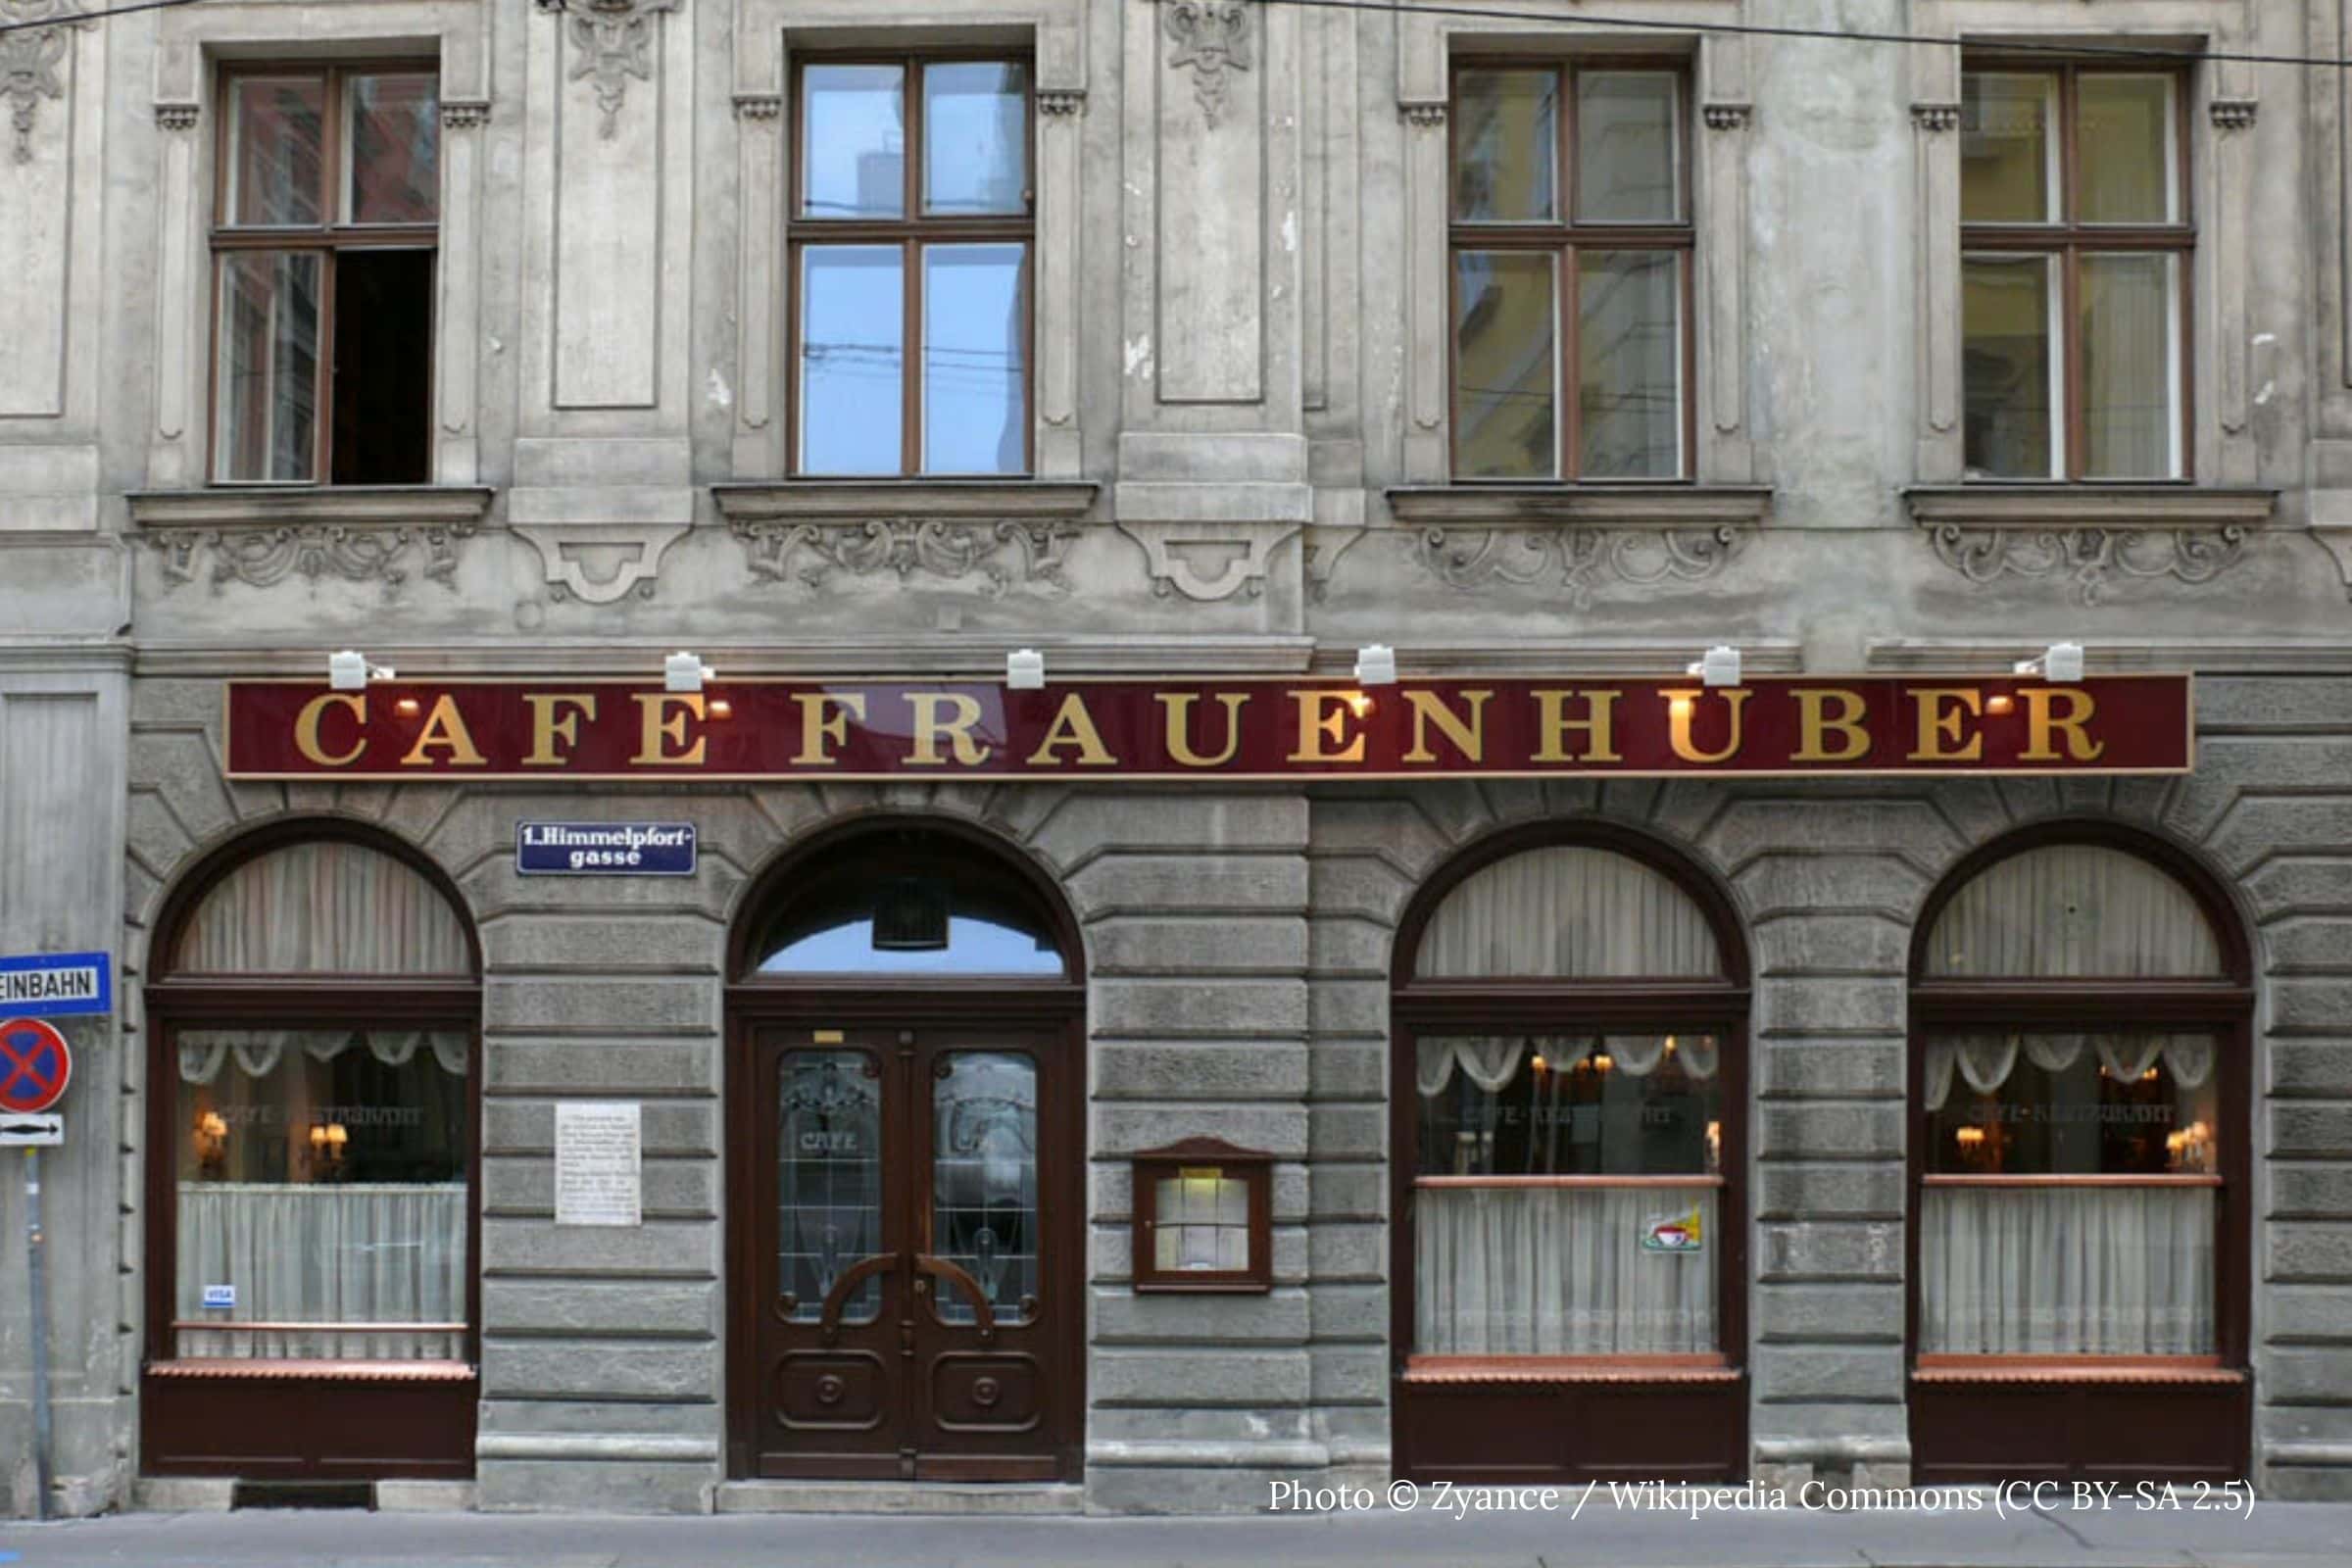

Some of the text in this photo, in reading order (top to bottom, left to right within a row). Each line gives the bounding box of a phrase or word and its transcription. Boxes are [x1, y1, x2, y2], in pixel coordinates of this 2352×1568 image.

[295, 688, 2105, 767] CAFE FRAUENHUBER
[569, 851, 642, 868] gasse
